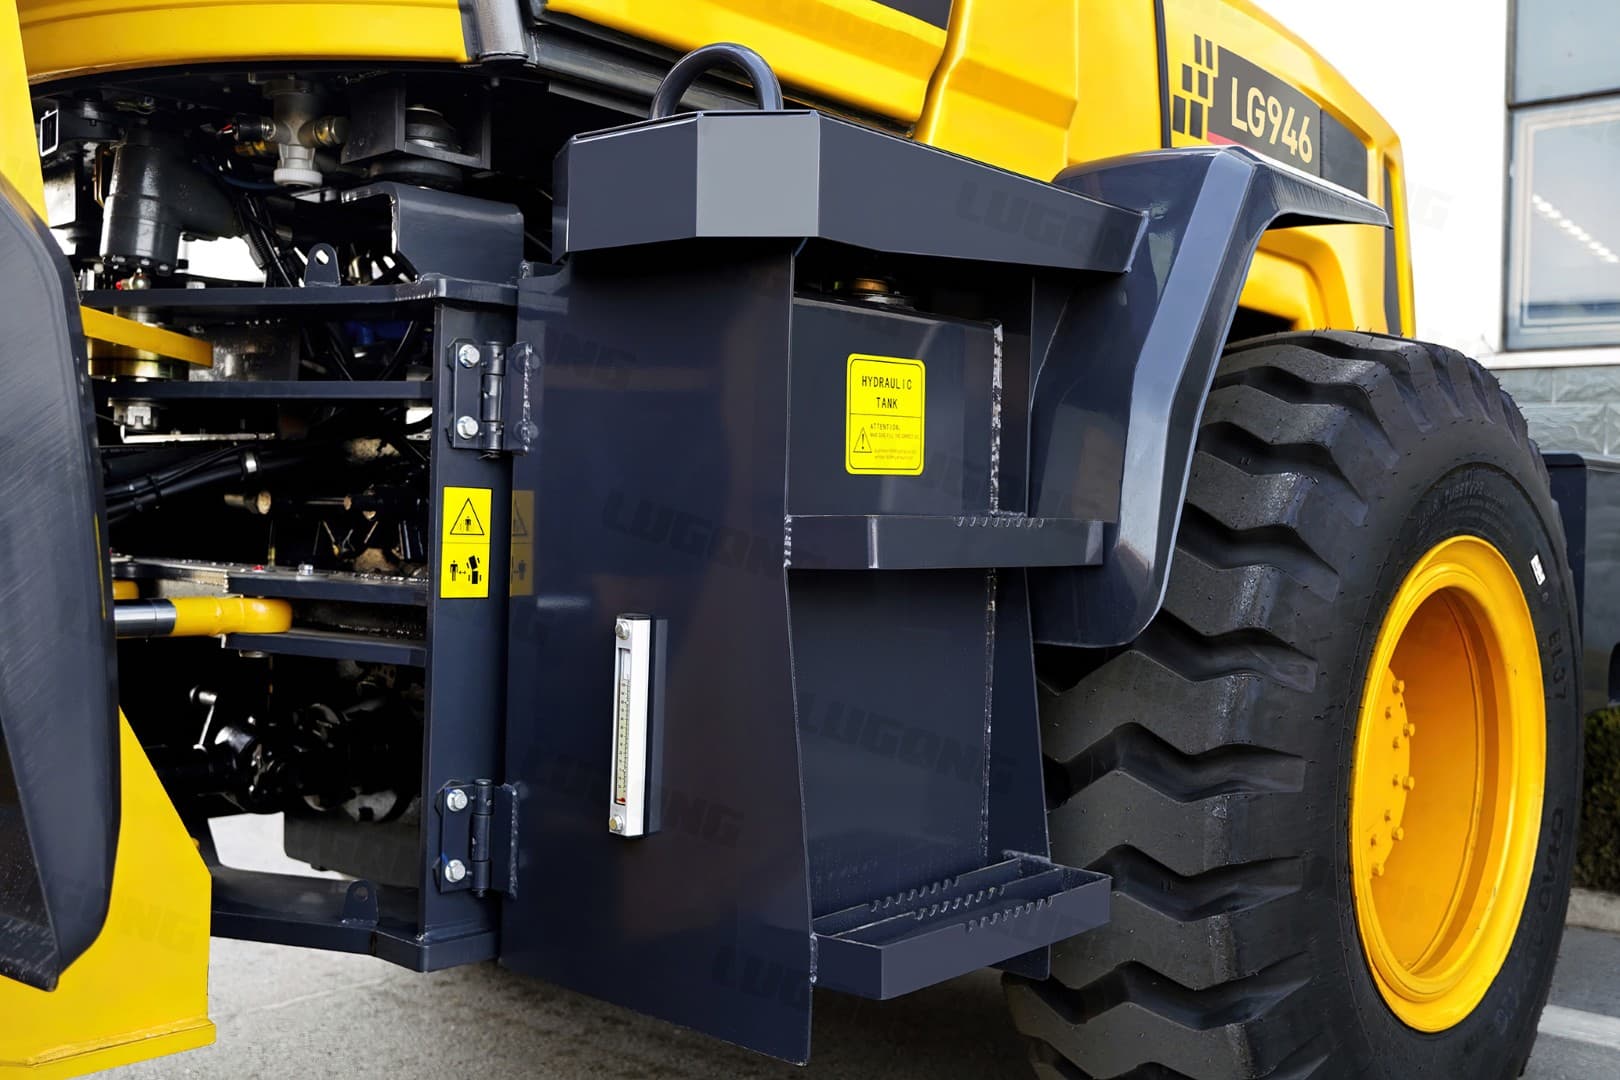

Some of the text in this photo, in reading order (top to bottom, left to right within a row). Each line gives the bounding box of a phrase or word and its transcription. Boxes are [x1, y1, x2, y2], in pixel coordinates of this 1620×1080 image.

[1231, 76, 1312, 164] LG946
[861, 375, 912, 390] HYDRAULIC
[876, 397, 898, 409] TANK
